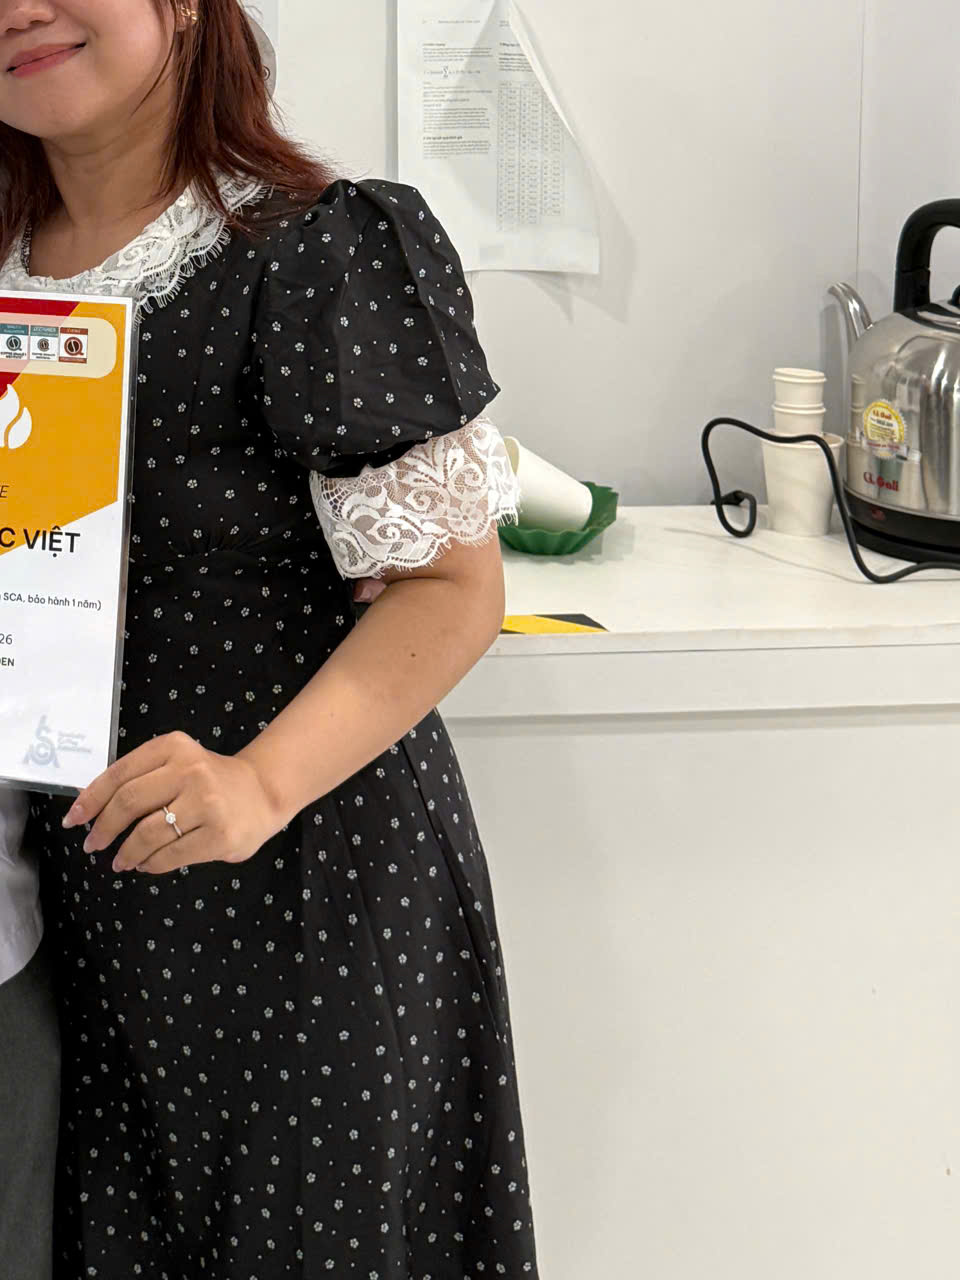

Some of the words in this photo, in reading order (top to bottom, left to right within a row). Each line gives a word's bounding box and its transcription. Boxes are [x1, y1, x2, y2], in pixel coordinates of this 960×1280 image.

[24, 525, 81, 557] VIỆT
[3, 592, 25, 604] SCA,
[28, 594, 46, 605] bảo
[48, 596, 70, 607] hành
[77, 599, 102, 611] năm)
